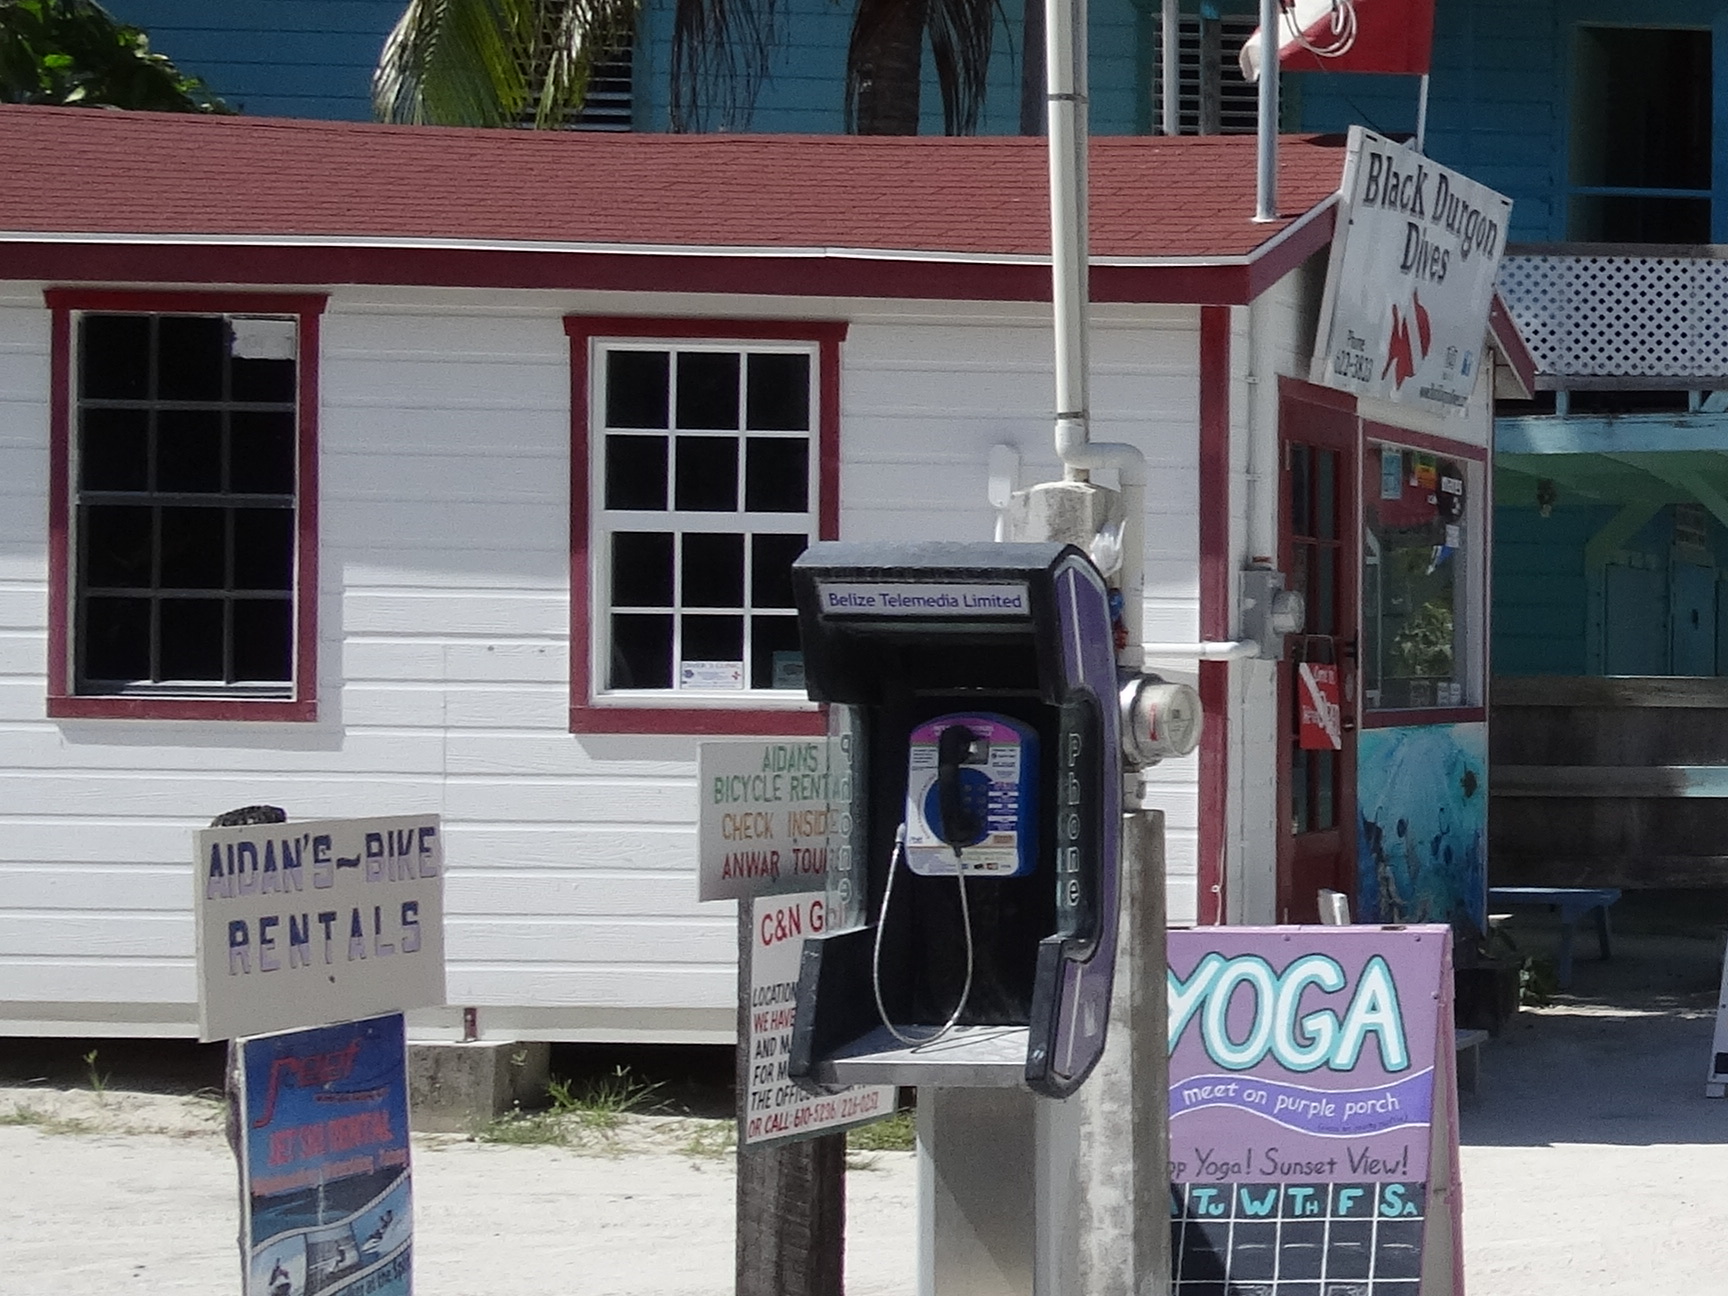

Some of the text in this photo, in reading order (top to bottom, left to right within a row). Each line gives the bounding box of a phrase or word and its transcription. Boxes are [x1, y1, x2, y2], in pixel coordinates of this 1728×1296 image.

[1431, 173, 1499, 263] Durgon
[1400, 220, 1450, 286] Dives
[828, 592, 1022, 608] Belize Telemedia Limited
[714, 774, 783, 804] BICYCLE
[722, 808, 839, 841] CHECK INSIDE
[722, 850, 781, 880] ANWAR
[228, 900, 422, 977] RENTALS
[761, 904, 801, 947] C&N
[753, 1006, 797, 1034] WE HAVE
[1167, 951, 1412, 1071] YOGA
[755, 1036, 777, 1060] AND
[752, 1064, 775, 1087] FOR
[751, 1089, 772, 1111] THE
[1182, 1082, 1400, 1122] meet on purple porch
[749, 1119, 762, 1139] OR
[1194, 1147, 1252, 1180] Yoga!
[1259, 1147, 1338, 1176] Sunset
[1346, 1144, 1409, 1176] View!
[1240, 1188, 1278, 1215] W
[1338, 1188, 1364, 1215] F
